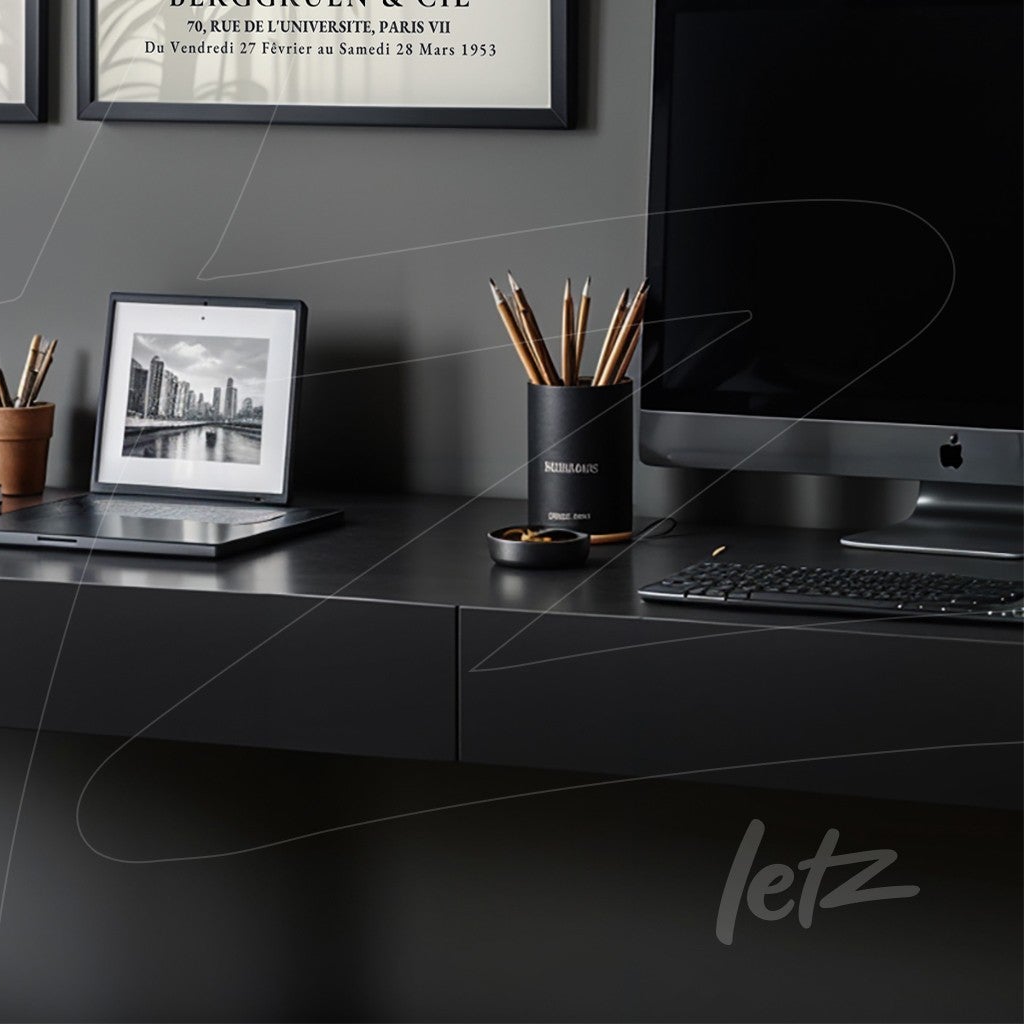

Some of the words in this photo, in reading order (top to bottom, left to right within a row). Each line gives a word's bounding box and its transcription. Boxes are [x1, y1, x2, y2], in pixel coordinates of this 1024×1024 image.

[187, 20, 206, 35] 70,
[210, 20, 241, 33] RUE
[244, 20, 264, 33] DE
[267, 20, 375, 36] L'UNIVERSITE,
[379, 20, 425, 34] PARIS
[428, 20, 451, 34] VII
[144, 40, 165, 54] Du
[170, 40, 235, 54] Vendredi
[240, 42, 256, 55] 27
[317, 45, 334, 55] au
[339, 41, 391, 56] Samedi
[396, 42, 414, 56] 28
[419, 43, 456, 56] Mars
[462, 43, 497, 57] 1953
